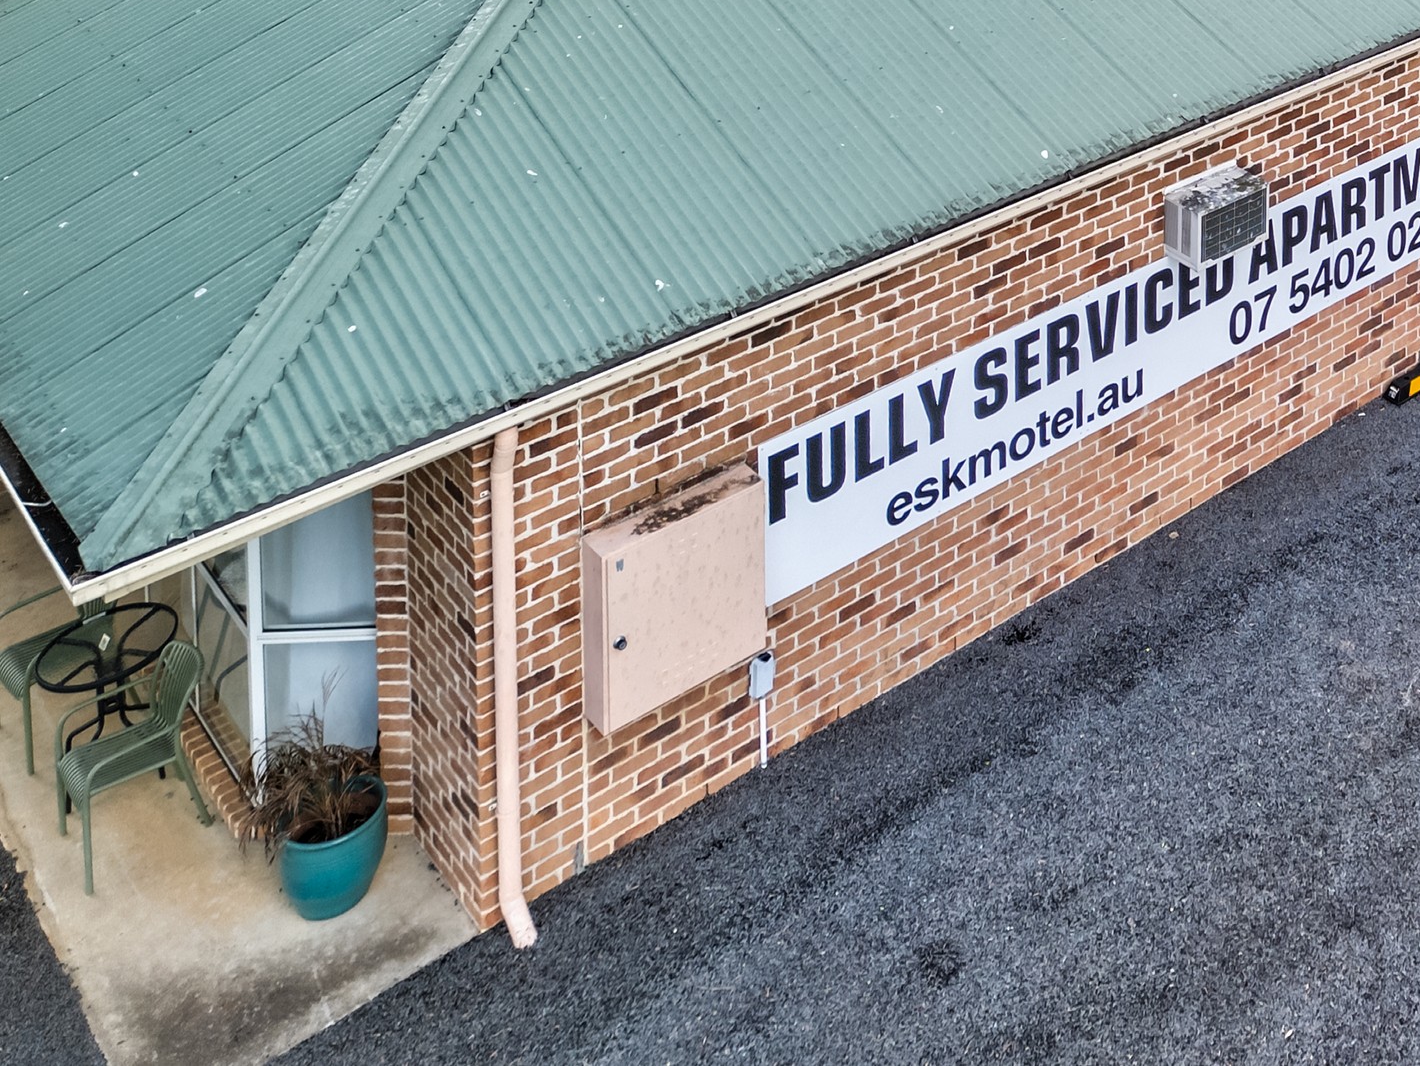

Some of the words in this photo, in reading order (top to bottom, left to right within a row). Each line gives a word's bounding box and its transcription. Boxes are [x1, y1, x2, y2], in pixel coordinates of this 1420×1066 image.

[1230, 284, 1277, 345] 07
[1289, 237, 1376, 314] 5402
[768, 369, 955, 525] FULLY
[973, 254, 1235, 420] SERVICED
[886, 369, 1144, 526] eskmotel.au
